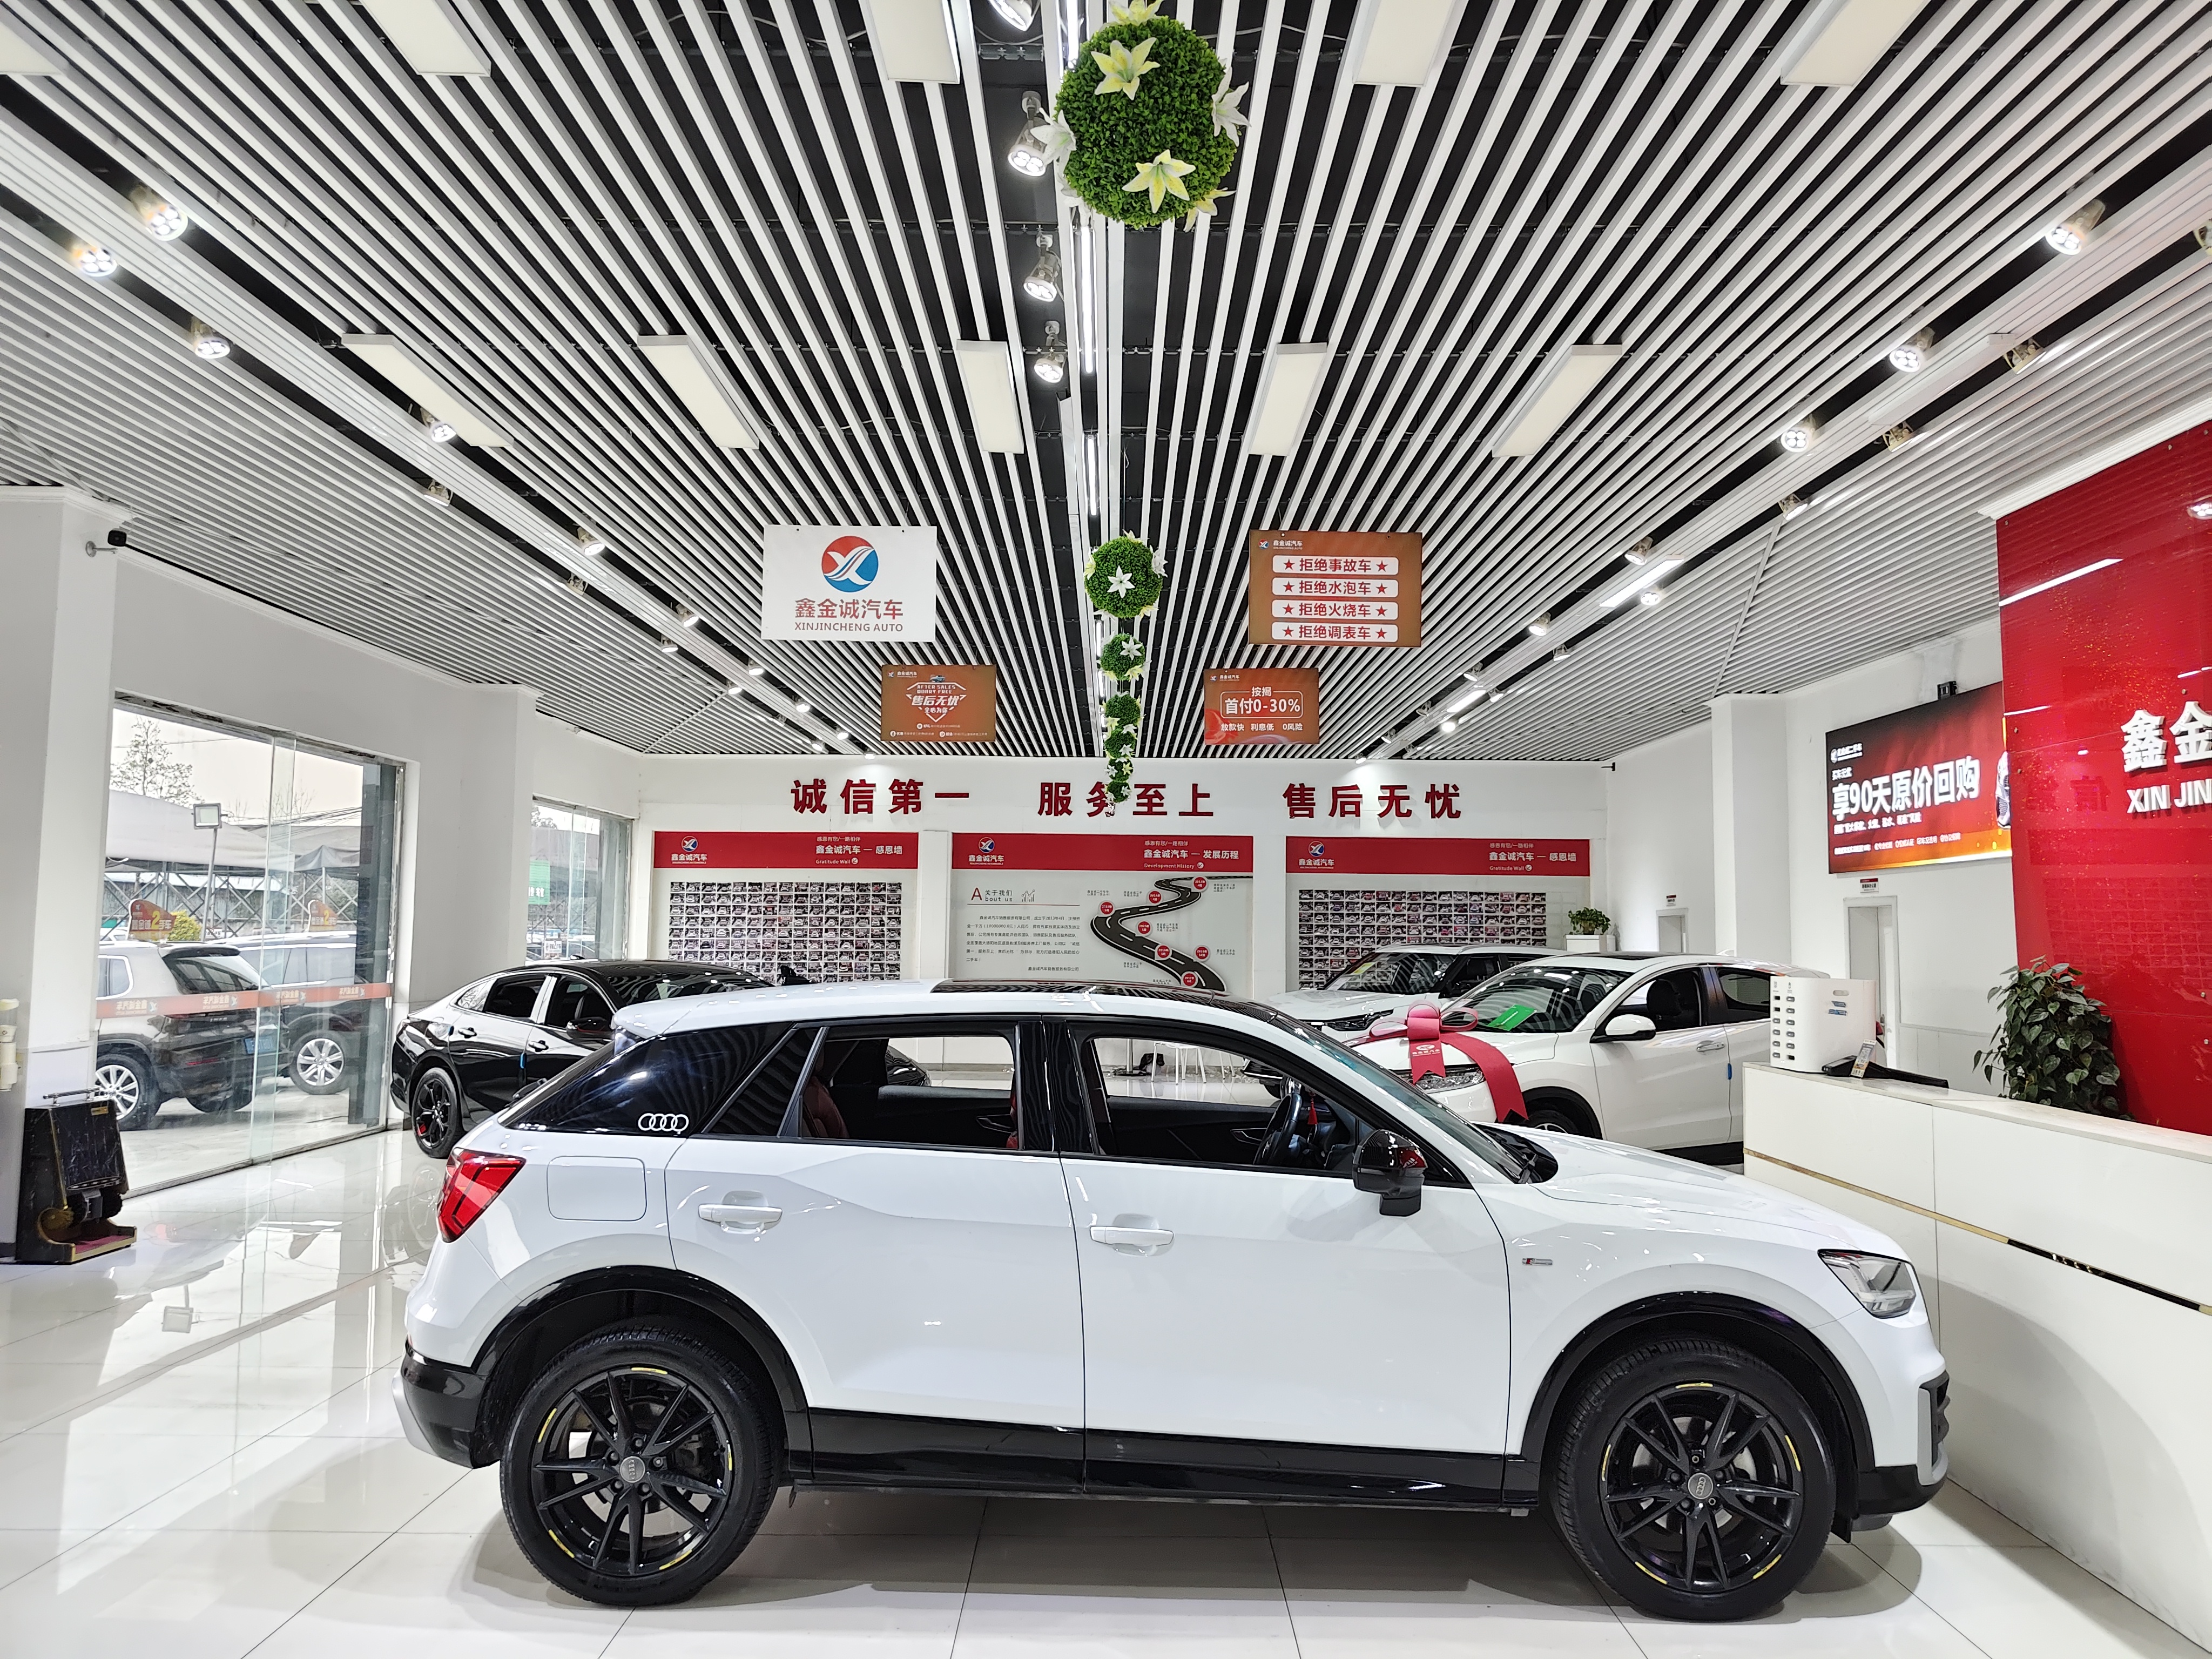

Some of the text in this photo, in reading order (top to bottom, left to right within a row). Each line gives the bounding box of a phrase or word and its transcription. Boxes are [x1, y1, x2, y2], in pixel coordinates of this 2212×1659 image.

[1299, 558, 1372, 572] 拒绝事故车
[1299, 581, 1371, 595] 拒绝水泡车
[795, 598, 903, 620] 鑫金诚汽车
[1299, 603, 1371, 617] 拒绝火烧车
[794, 623, 903, 632] XINJINCHENG AUTO
[1299, 625, 1371, 639] 拒绝调表车
[1251, 686, 1272, 697] 按揭
[911, 696, 959, 706] 售后无忧
[1224, 698, 1300, 714] 首付0-30%
[2121, 701, 2212, 773] 鑫金
[1832, 756, 1980, 821] 享90天原价回购
[791, 779, 969, 815] 诚信第一
[1283, 783, 1461, 819] 售后无忧
[2127, 785, 2171, 813] XIN
[816, 845, 861, 854] 鑫金诚汽车
[875, 846, 903, 854] 感恩墙
[1144, 849, 1188, 858] 鑫金诚汽车
[1203, 850, 1239, 859] 发展历程
[1489, 852, 1534, 861] 鑫金诚汽车
[1549, 853, 1576, 861] 感恩墙
[971, 887, 982, 901] A
